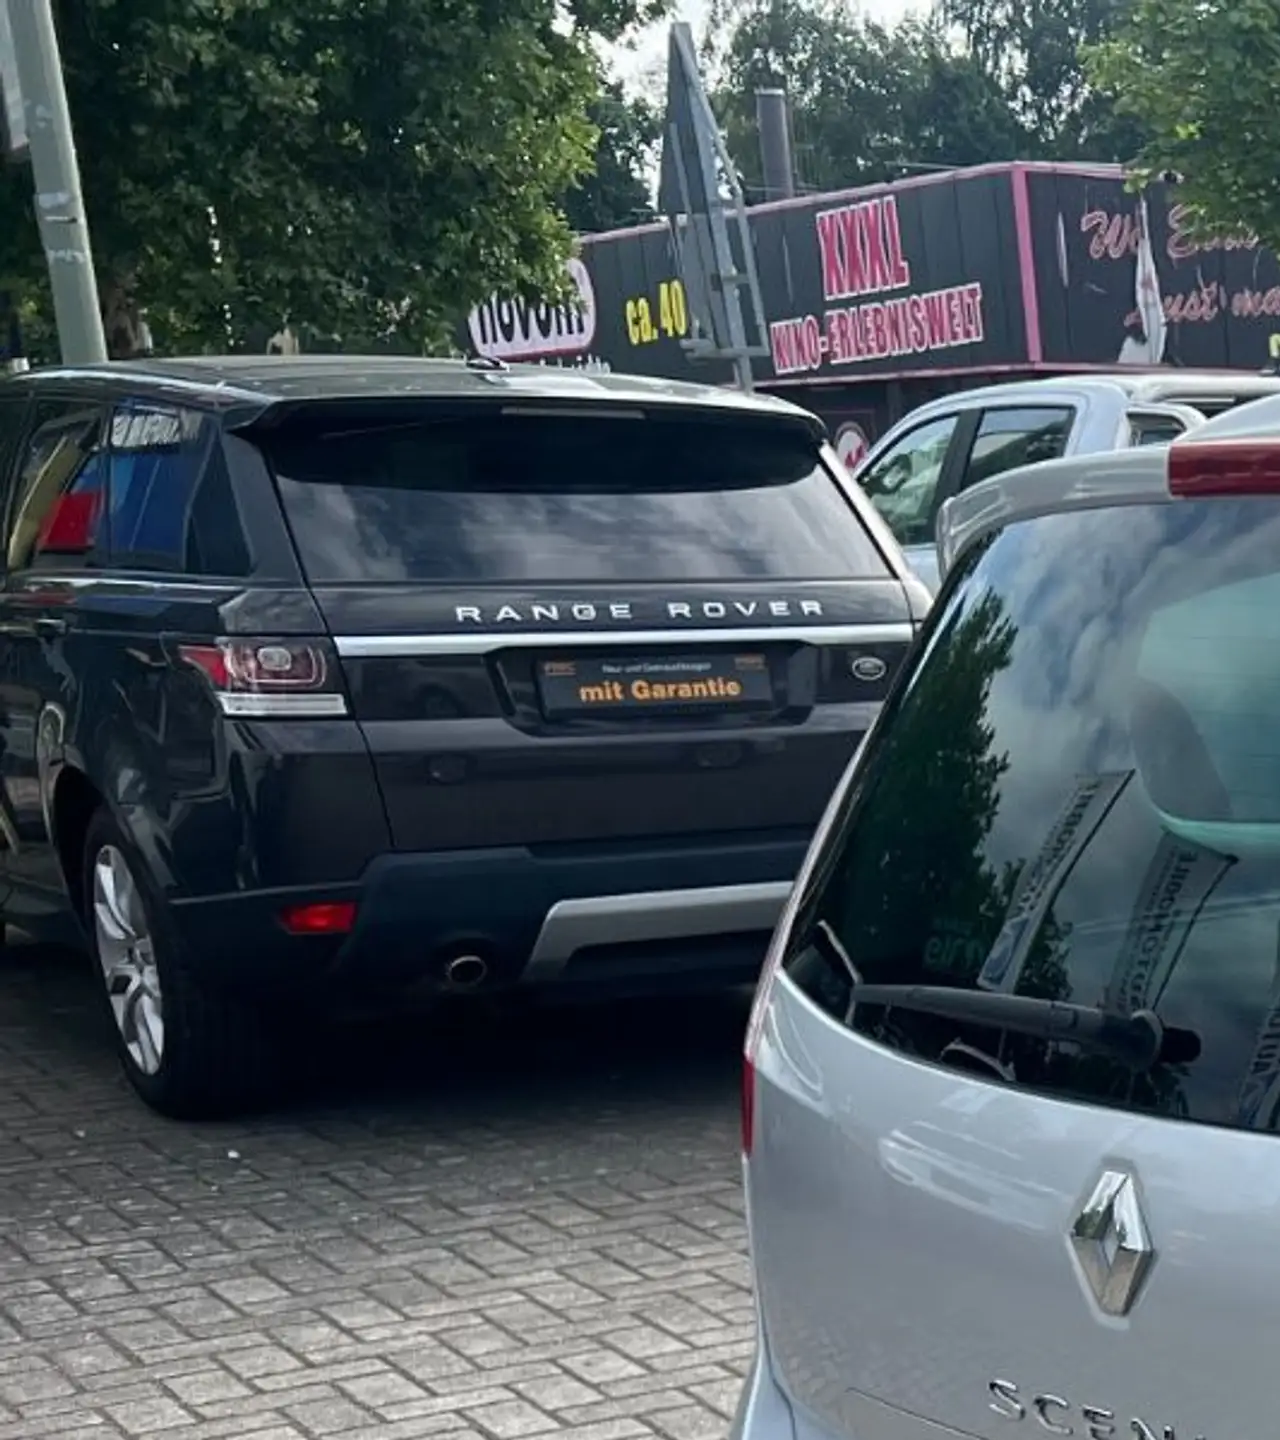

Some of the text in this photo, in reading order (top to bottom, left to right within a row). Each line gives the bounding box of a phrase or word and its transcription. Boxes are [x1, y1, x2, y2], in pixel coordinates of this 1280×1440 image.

[1080, 210, 1143, 258] W
[626, 297, 658, 345] ca.
[770, 282, 984, 375] KINO-ERLEBNISWELT
[456, 599, 824, 624] RANGE ROVER
[579, 676, 742, 703] mit Garantie
